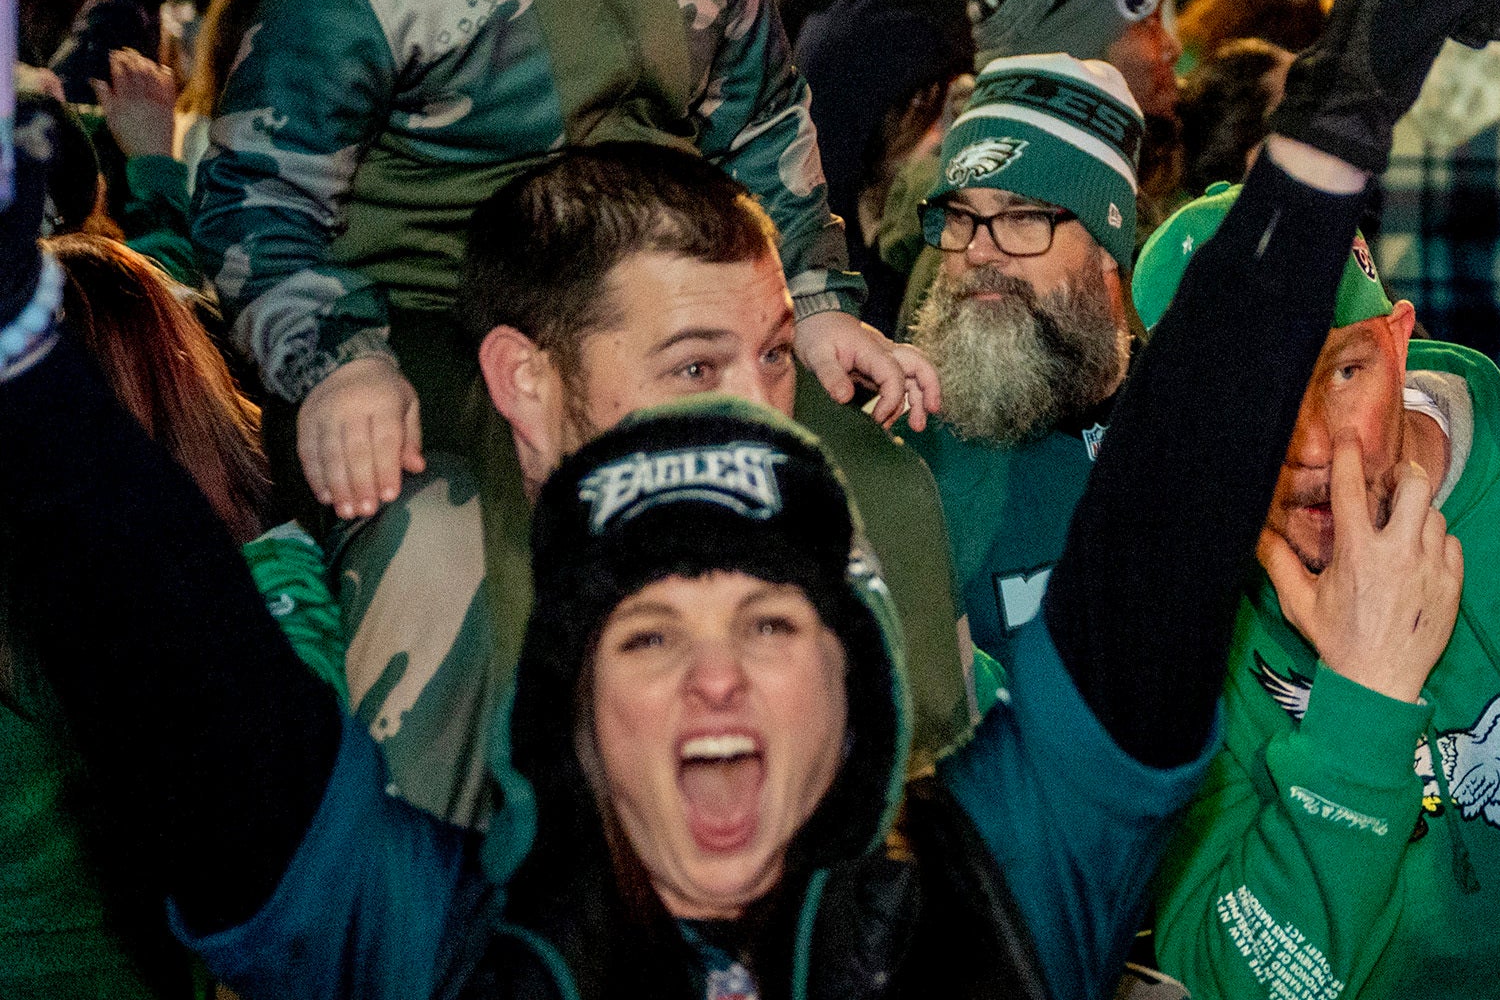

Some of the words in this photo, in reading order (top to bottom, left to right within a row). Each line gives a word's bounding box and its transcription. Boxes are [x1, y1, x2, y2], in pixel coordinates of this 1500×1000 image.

[578, 442, 789, 533] EAGLES
[1217, 896, 1231, 923] NFL
[1229, 926, 1252, 957] NEW
[1260, 929, 1278, 952] THE
[1276, 951, 1292, 964] OF
[1294, 950, 1315, 970] NEW
[1271, 961, 1304, 993] NAMED
[1289, 962, 1320, 994] HONOR
